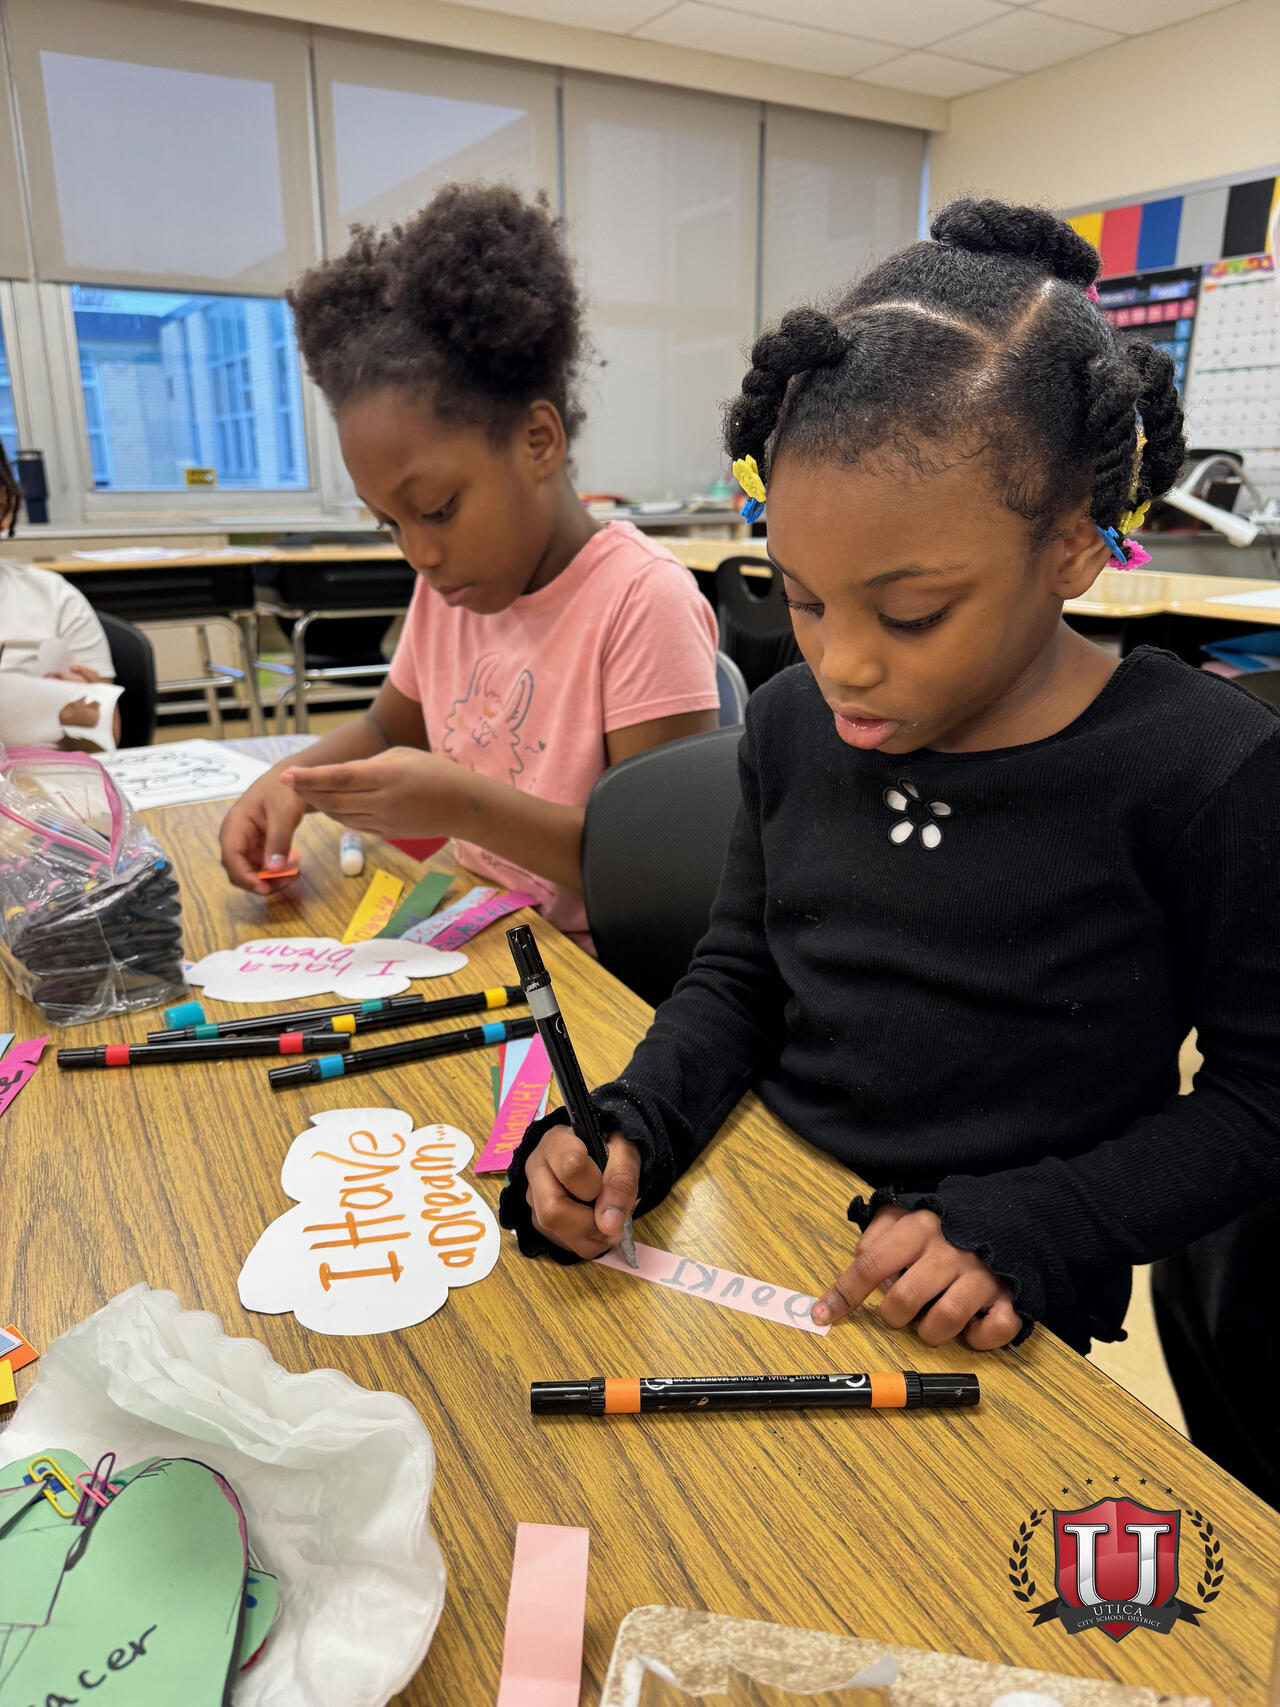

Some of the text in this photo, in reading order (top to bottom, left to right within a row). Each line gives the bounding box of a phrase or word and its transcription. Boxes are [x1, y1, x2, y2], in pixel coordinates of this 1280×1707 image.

[244, 944, 356, 963] Dream
[365, 959, 407, 977] I
[302, 1129, 412, 1292] I Have
[437, 1246, 478, 1269] a
